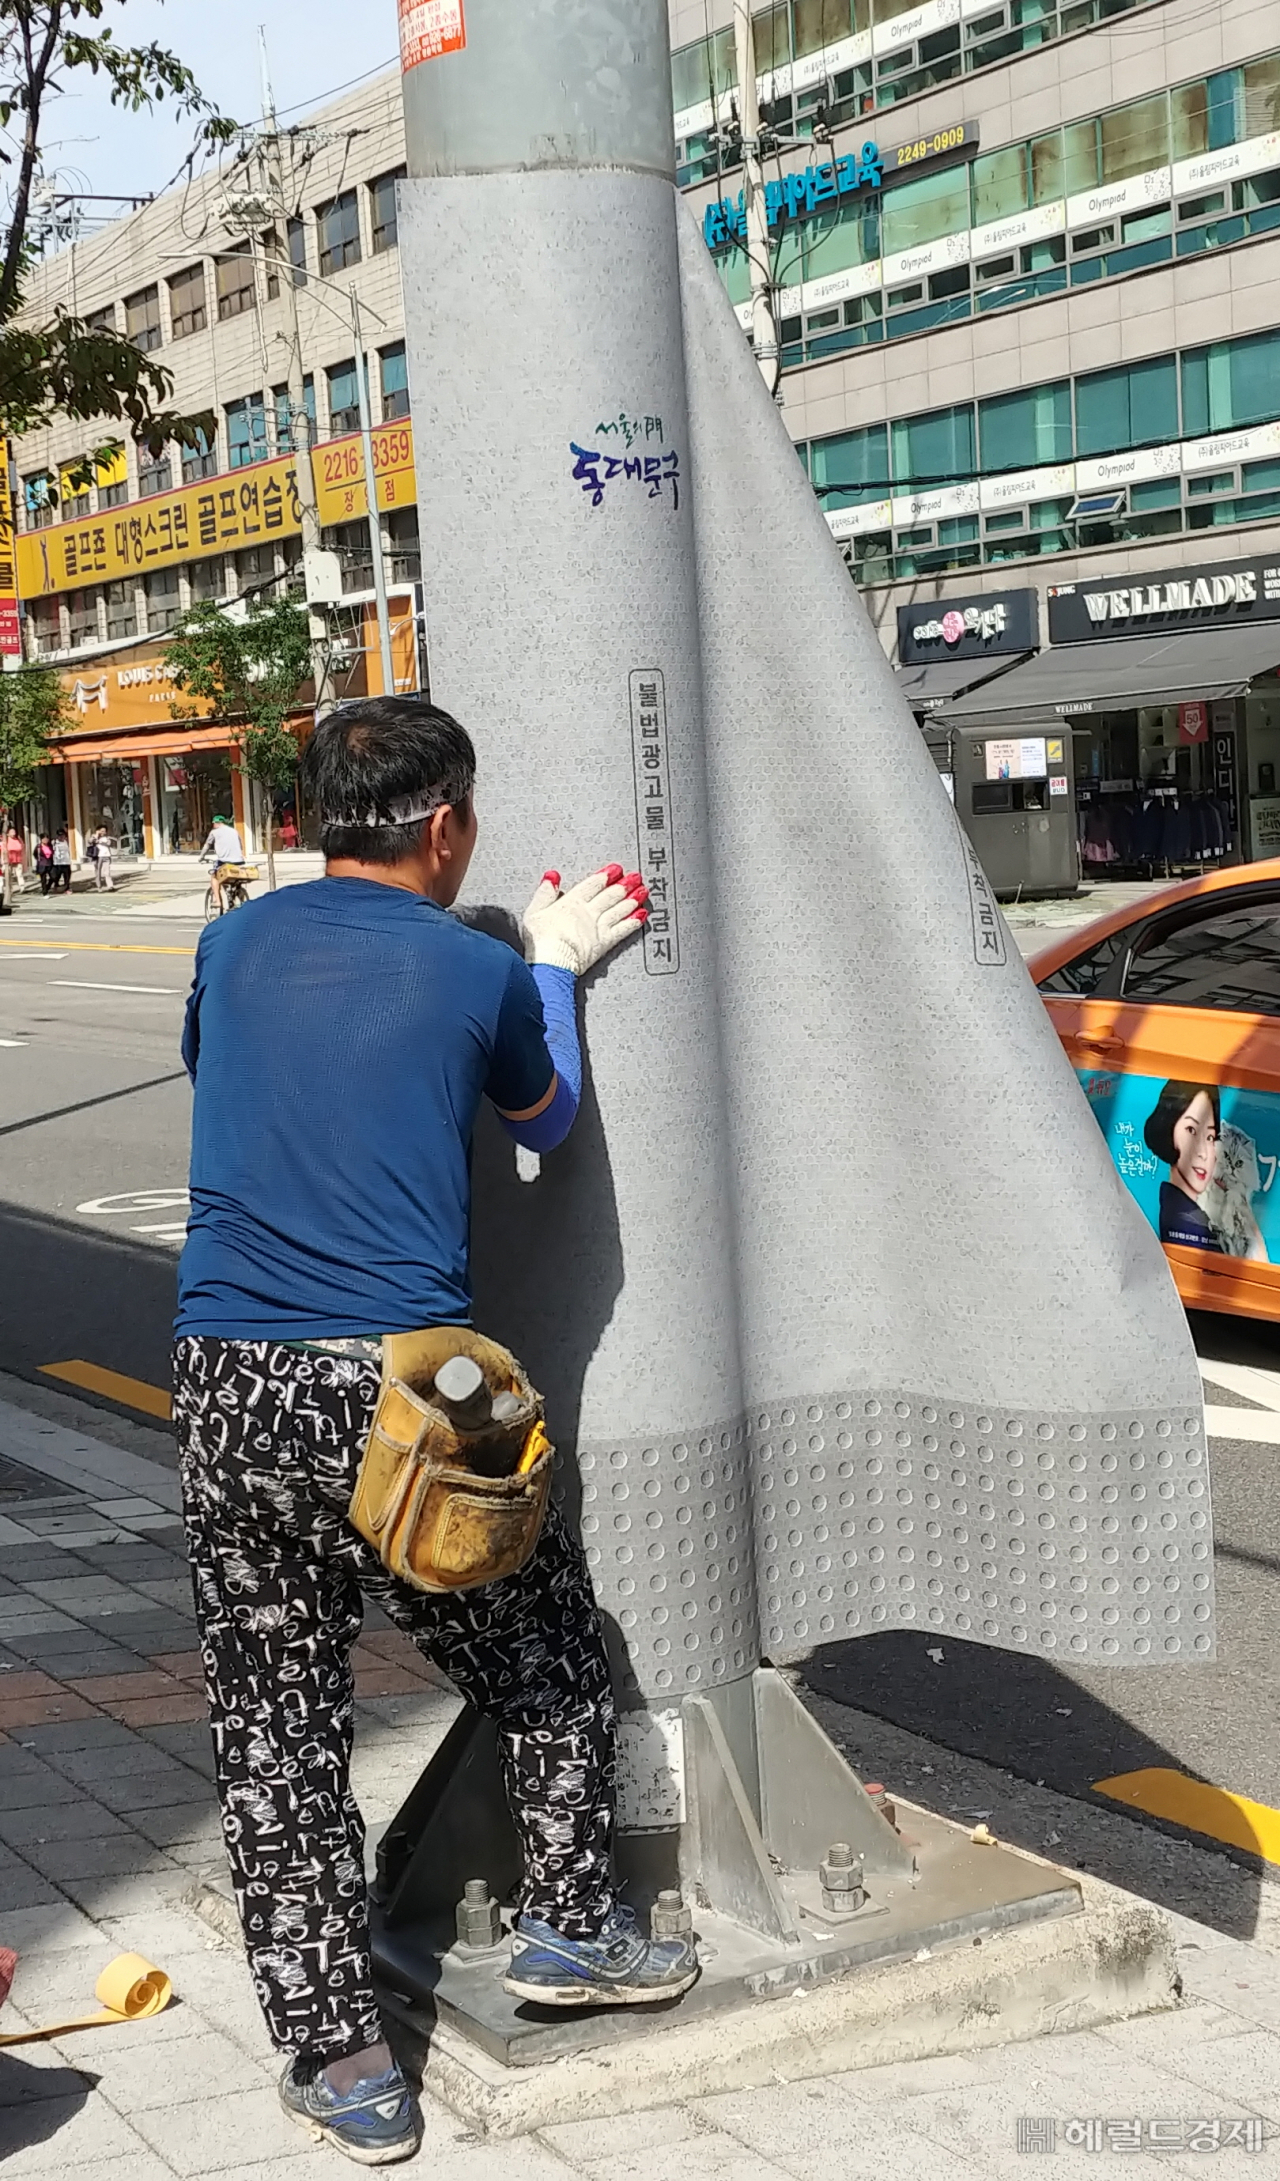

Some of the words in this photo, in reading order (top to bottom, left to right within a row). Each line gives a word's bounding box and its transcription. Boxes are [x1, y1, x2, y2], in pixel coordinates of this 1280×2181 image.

[891, 15, 923, 38] Olympiad
[897, 126, 964, 166] 2249-0909
[1088, 189, 1126, 212] Olympiad
[900, 251, 932, 271] Olympiad
[323, 430, 410, 483] 2216-3359
[569, 441, 680, 511] 동대문구
[1097, 458, 1136, 479] Olympiad
[910, 498, 943, 515] Olympiad
[114, 502, 189, 565] 대형스크린
[1083, 571, 1257, 622] WELLMADE
[117, 666, 154, 687] LOUIS
[1055, 703, 1093, 714] WELLMADE
[1186, 713, 1199, 725] 50
[638, 682, 665, 831] 불법광고물
[648, 846, 672, 964] 부착금지
